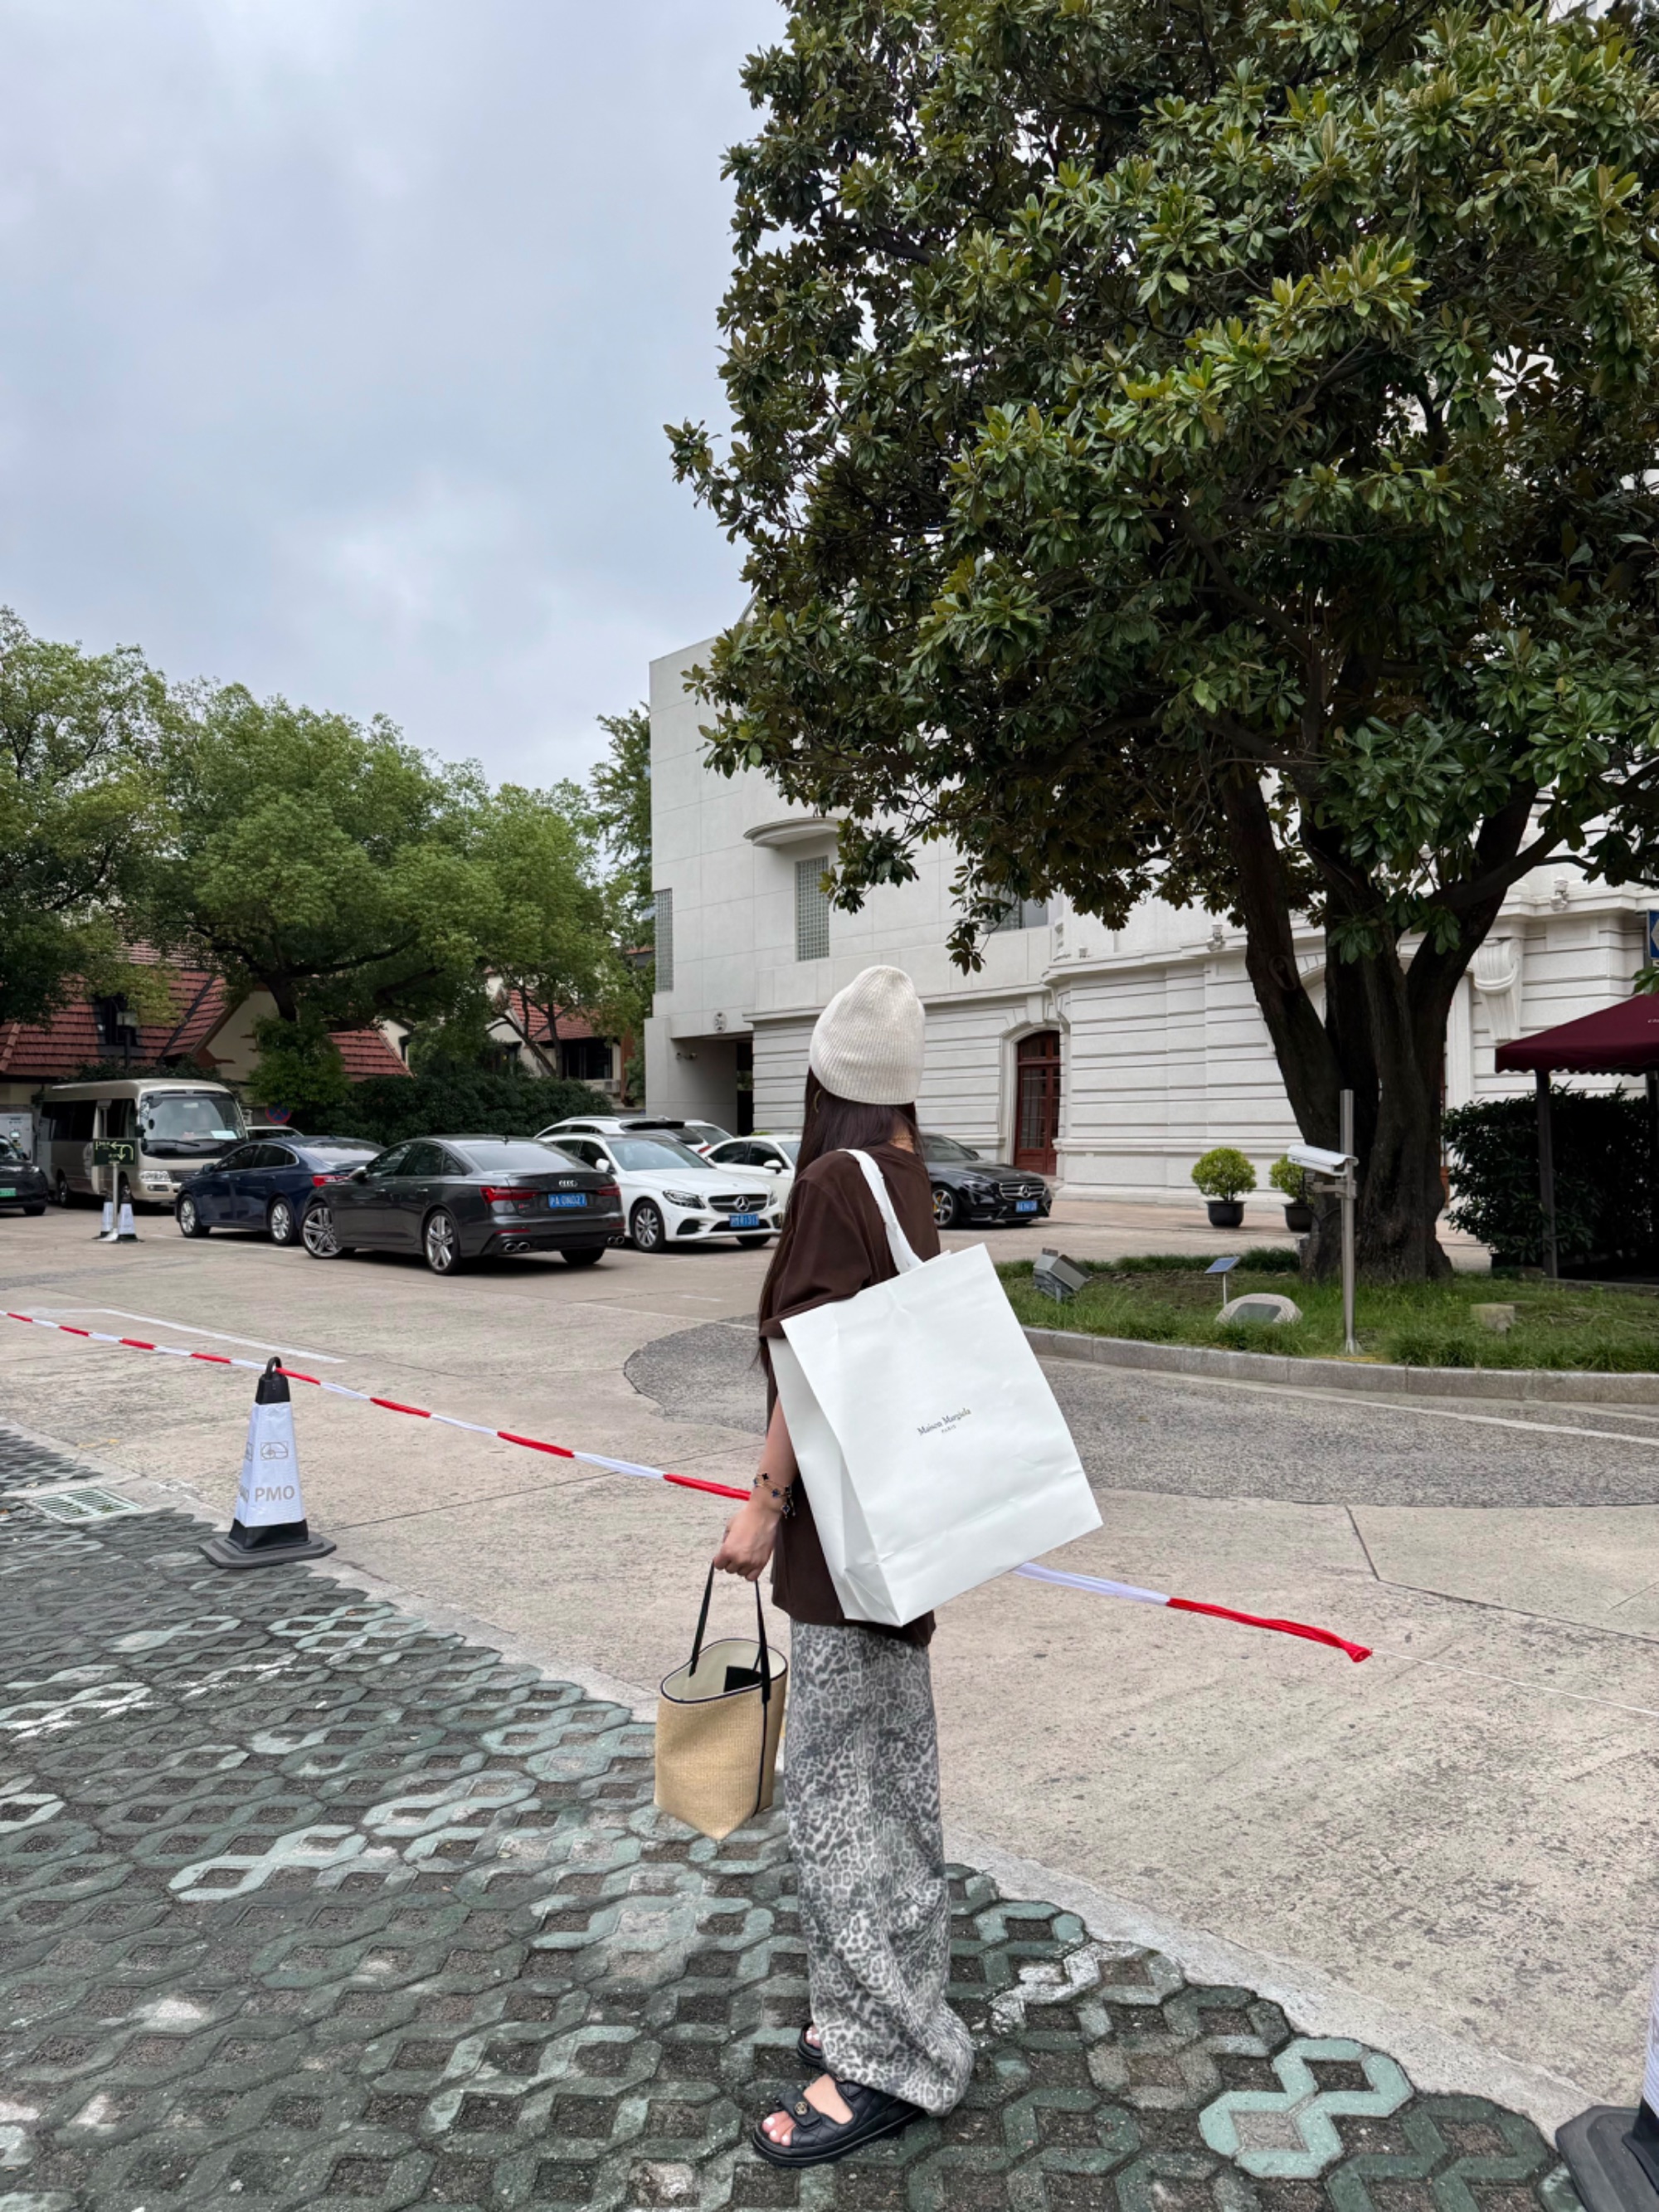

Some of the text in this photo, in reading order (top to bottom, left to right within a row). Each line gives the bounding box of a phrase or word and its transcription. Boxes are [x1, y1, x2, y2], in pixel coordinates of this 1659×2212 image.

[917, 1407, 971, 1435] Maison Margiela
[941, 1424, 956, 1434] PARIS
[255, 1484, 295, 1503] PMO
